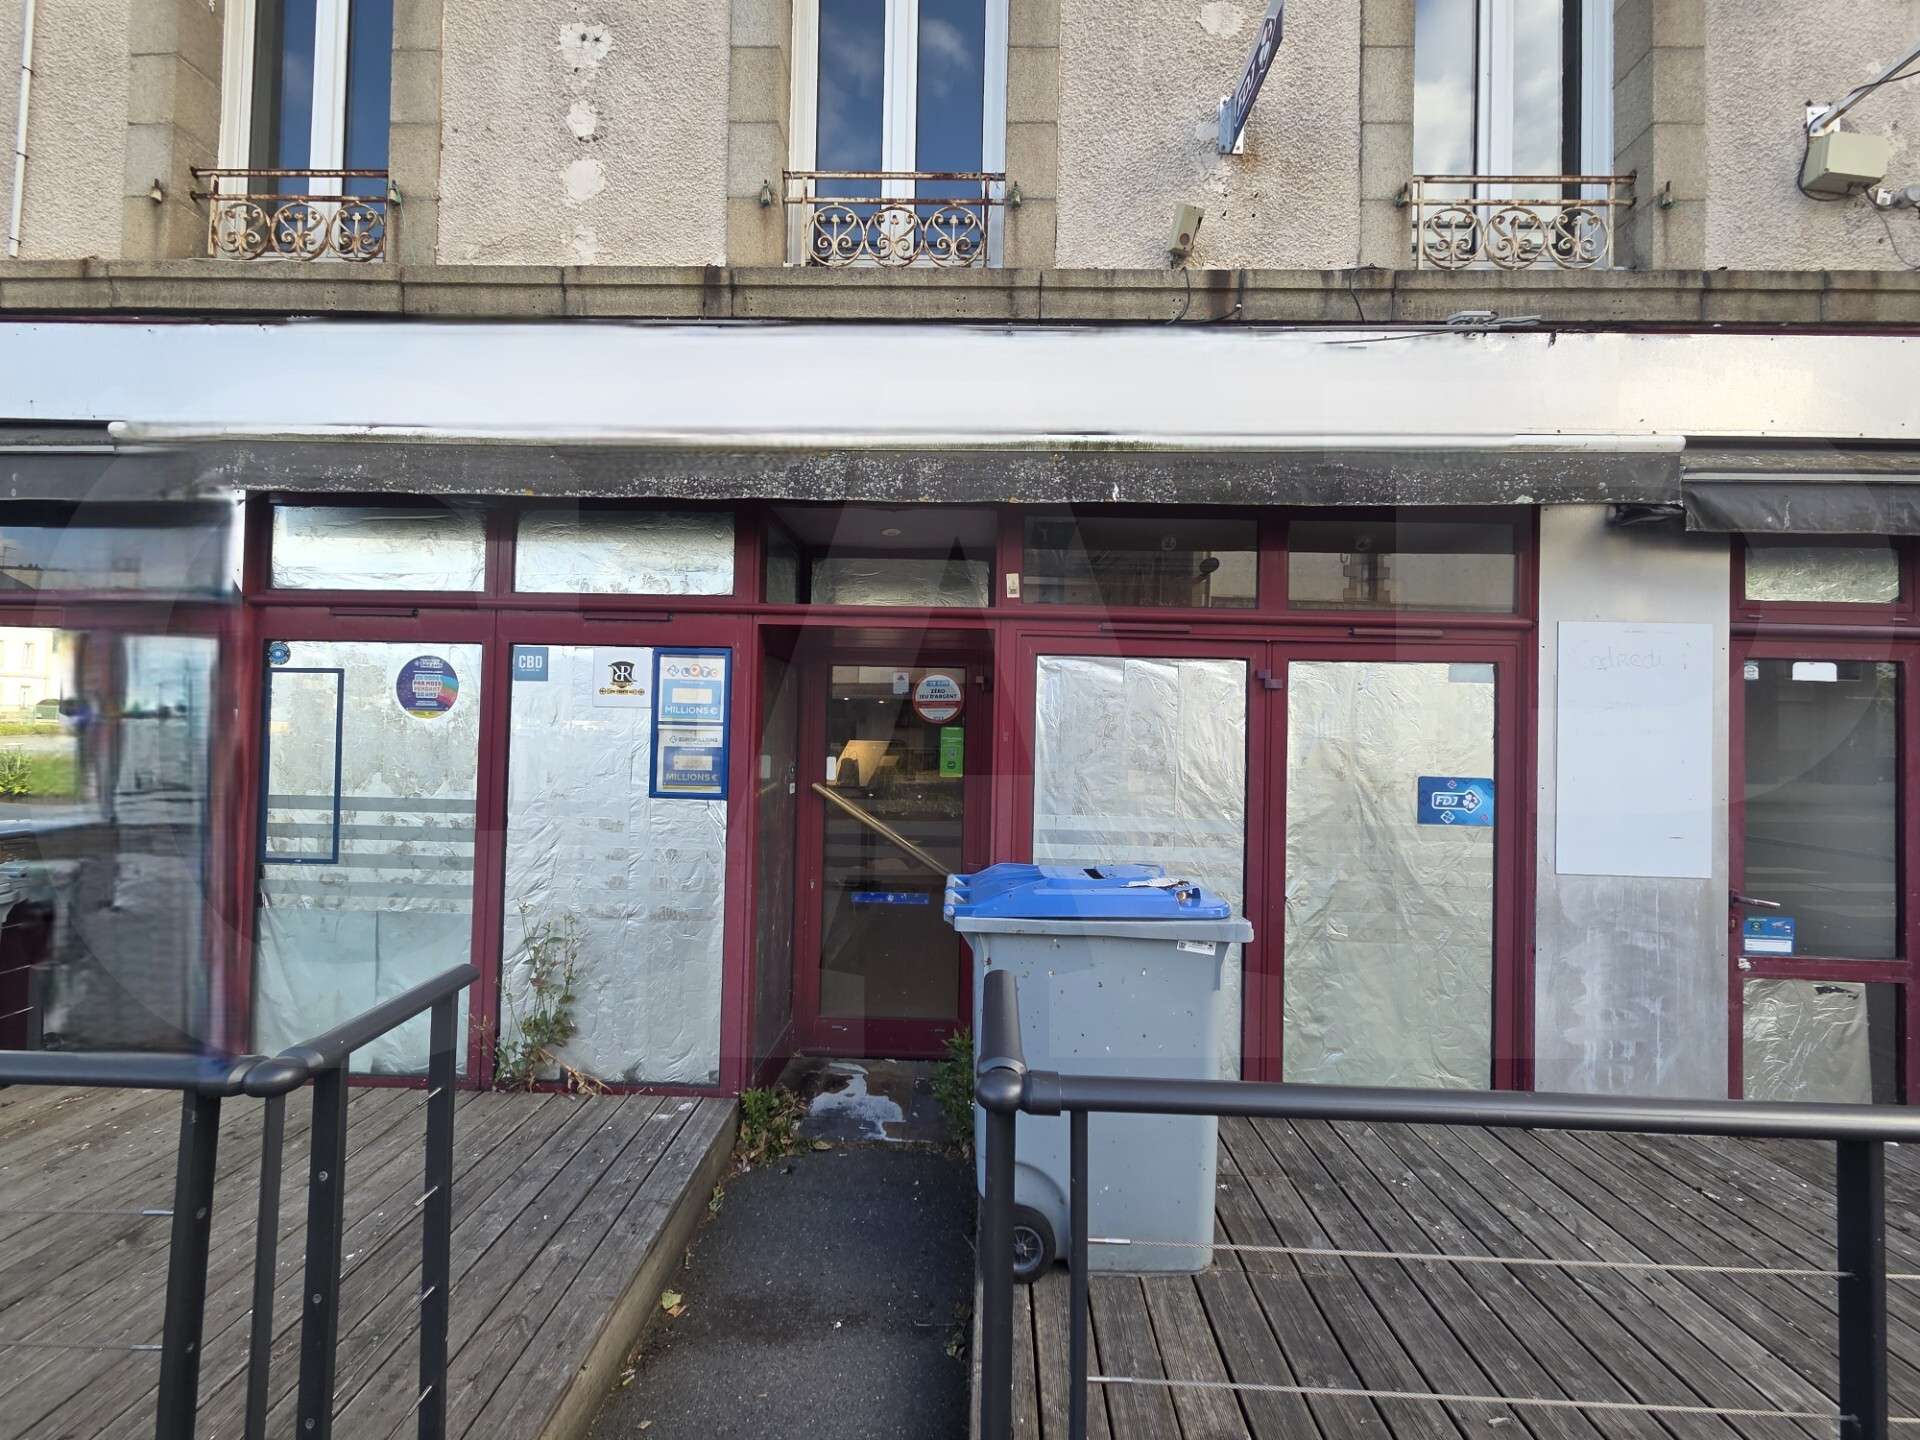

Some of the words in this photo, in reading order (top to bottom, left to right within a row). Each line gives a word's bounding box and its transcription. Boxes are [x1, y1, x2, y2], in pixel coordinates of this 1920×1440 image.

[518, 655, 543, 669] CBD
[665, 705, 709, 714] MILLIONS
[665, 773, 711, 782] MILLIONS
[1435, 796, 1459, 806] FDJ
